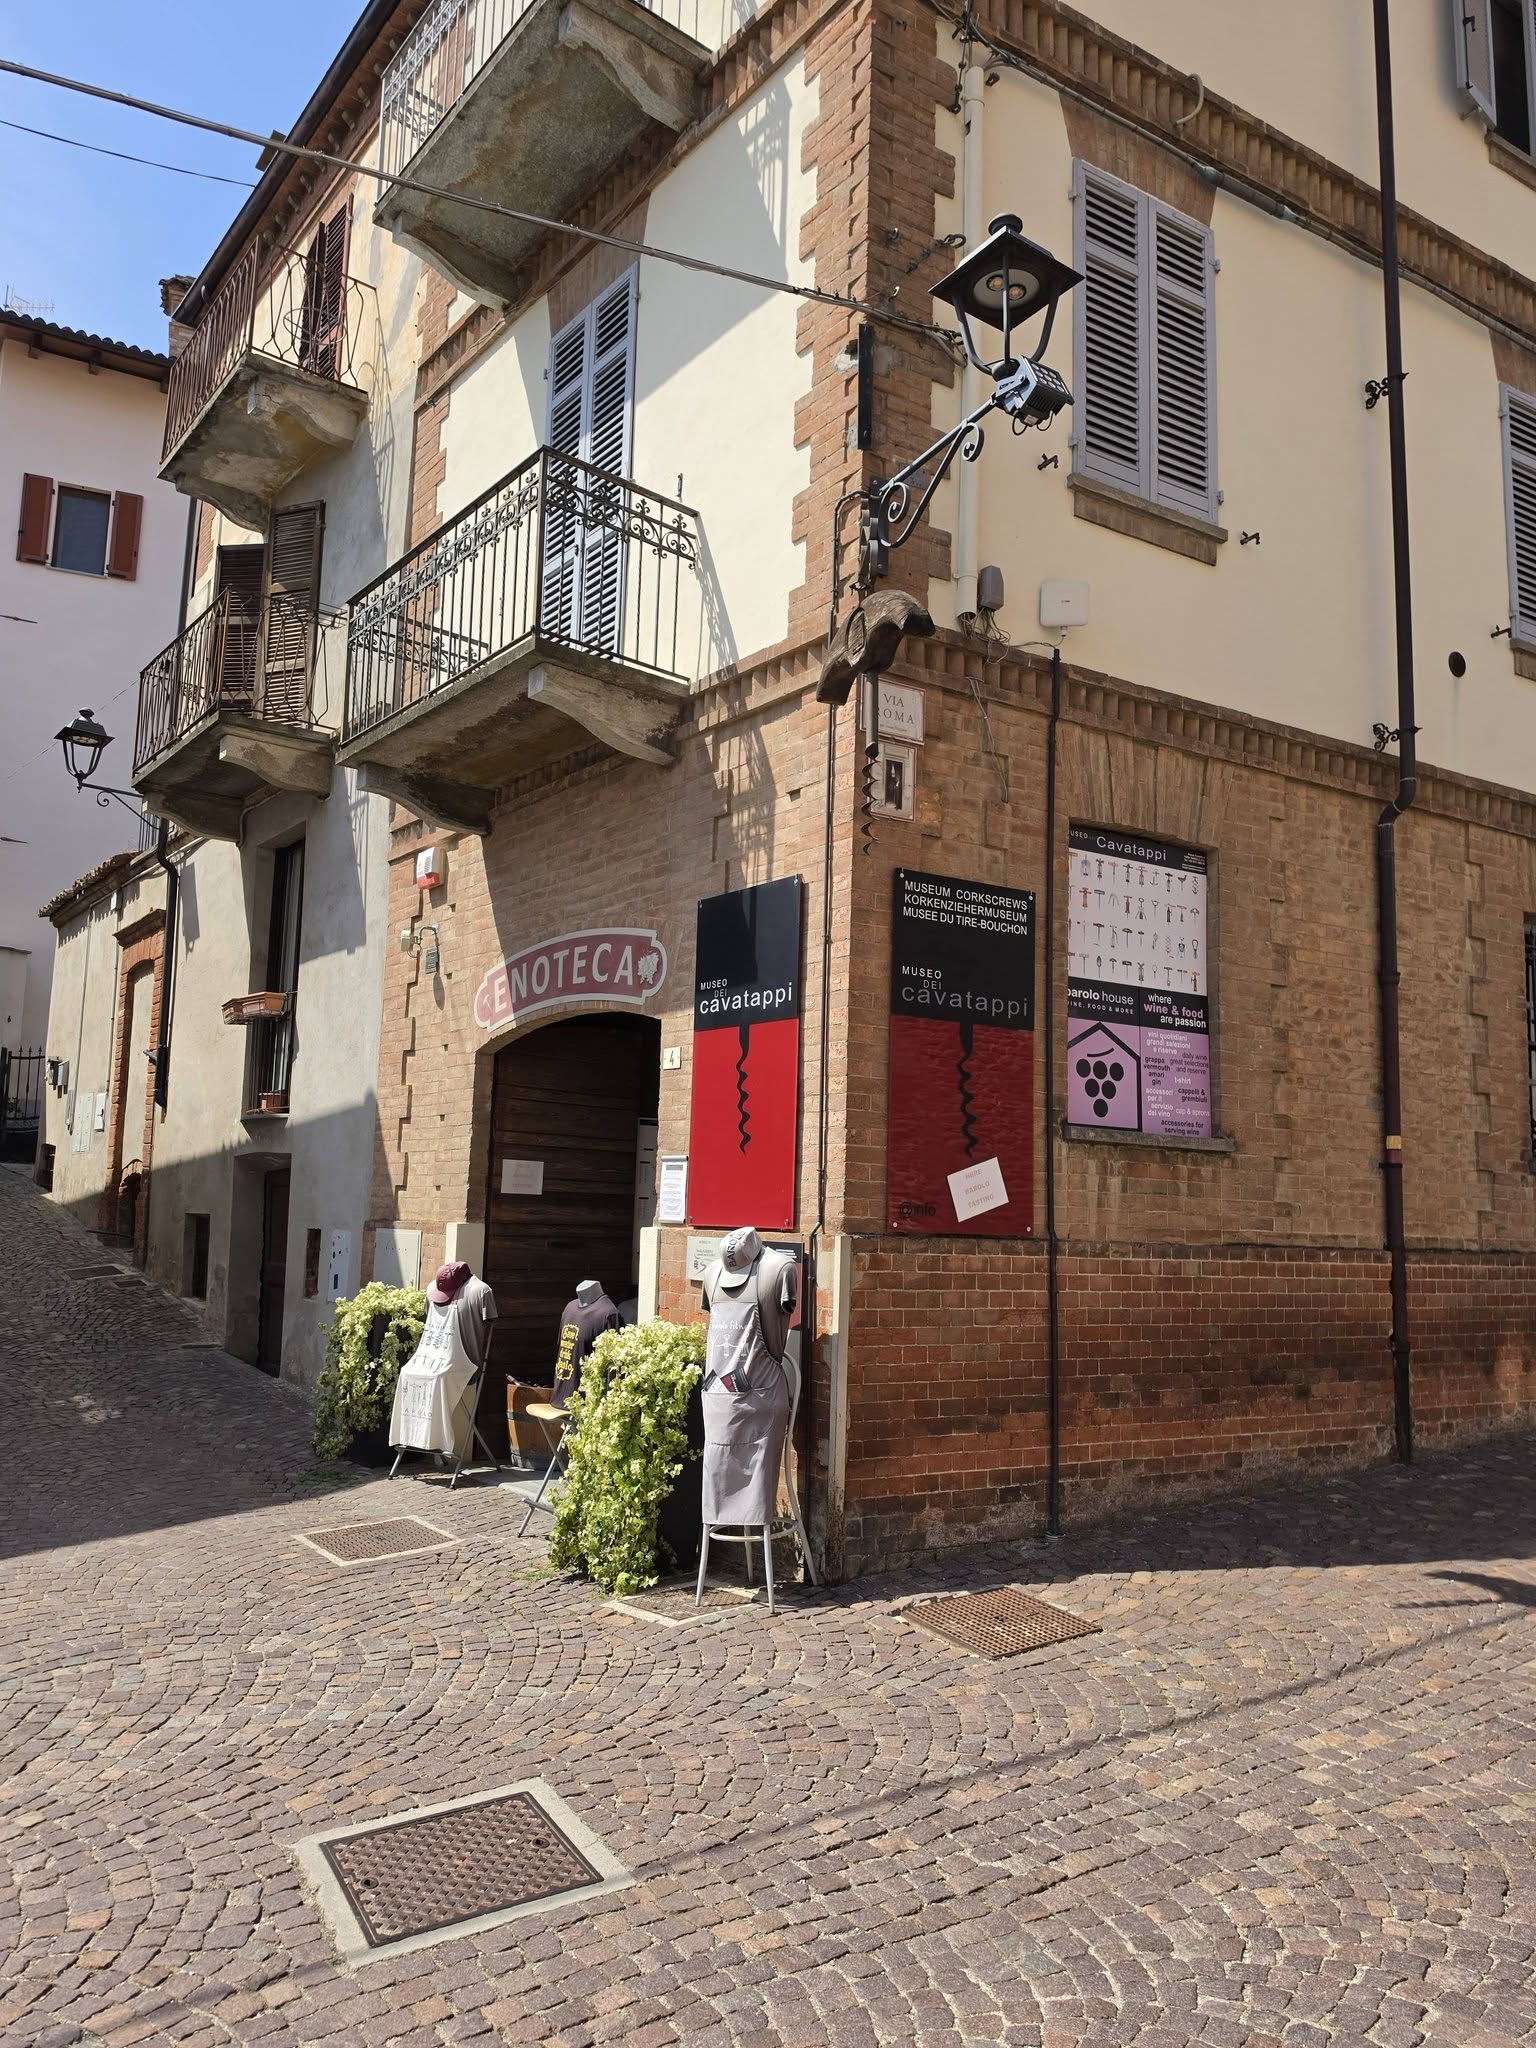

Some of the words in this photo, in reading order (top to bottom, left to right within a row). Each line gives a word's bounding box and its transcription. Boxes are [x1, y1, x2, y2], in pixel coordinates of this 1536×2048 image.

[884, 694, 904, 708] VIA
[1070, 830, 1088, 839] USEO
[1096, 836, 1166, 861] Cavatappi
[904, 880, 951, 898] MUSEUM
[956, 889, 1028, 911] CORKSCREWS
[904, 894, 1027, 923] KORKENZIEHERMUSEUM
[903, 906, 938, 921] MUSEE
[940, 912, 954, 924] DU
[956, 914, 1028, 936] TIRE-BOUCHON
[494, 942, 633, 1014] ENOTECA
[902, 965, 942, 980] MUSEO
[700, 978, 728, 990] MUSEO
[923, 979, 942, 990] DEI
[700, 982, 792, 1014] cavatappi
[714, 988, 727, 998] DEI
[1102, 990, 1134, 1006] house
[1148, 993, 1172, 1004] where
[902, 986, 1028, 1019] cavatappi
[1115, 1007, 1134, 1015] MORE
[1144, 1003, 1168, 1014] wine
[1172, 1006, 1179, 1016] &
[1182, 1007, 1204, 1019] food
[1160, 1014, 1174, 1024] are
[1175, 1016, 1207, 1028] passion
[669, 1050, 674, 1066] 4
[1144, 1056, 1165, 1064] grappa
[1144, 1063, 1170, 1072] vermouth
[1161, 1120, 1194, 1128] accessories
